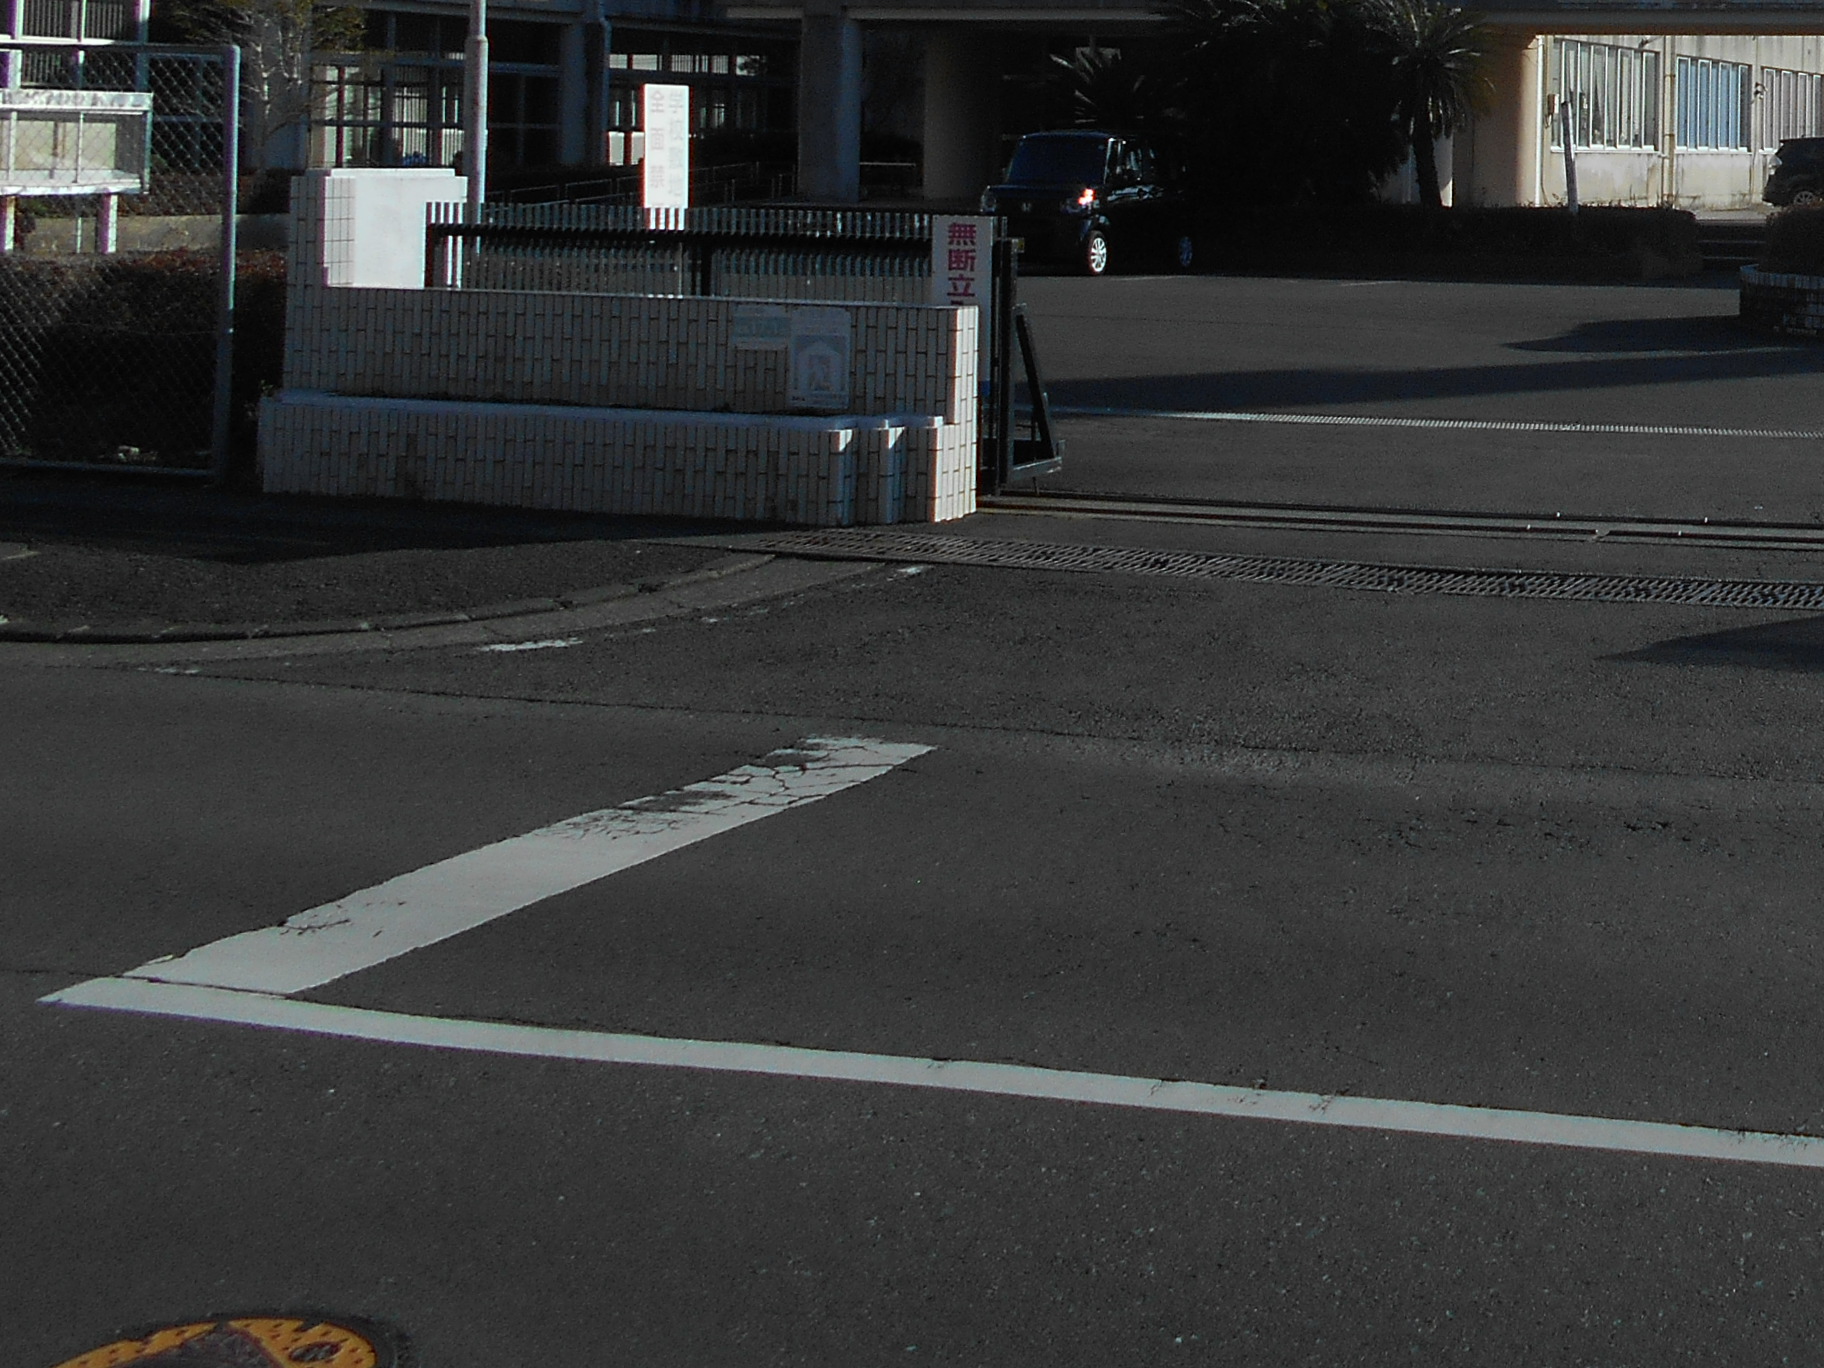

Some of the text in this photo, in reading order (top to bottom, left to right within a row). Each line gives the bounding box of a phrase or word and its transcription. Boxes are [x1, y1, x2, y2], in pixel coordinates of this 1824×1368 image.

[650, 90, 665, 206] 全面禁
[947, 222, 977, 305] 無断立
